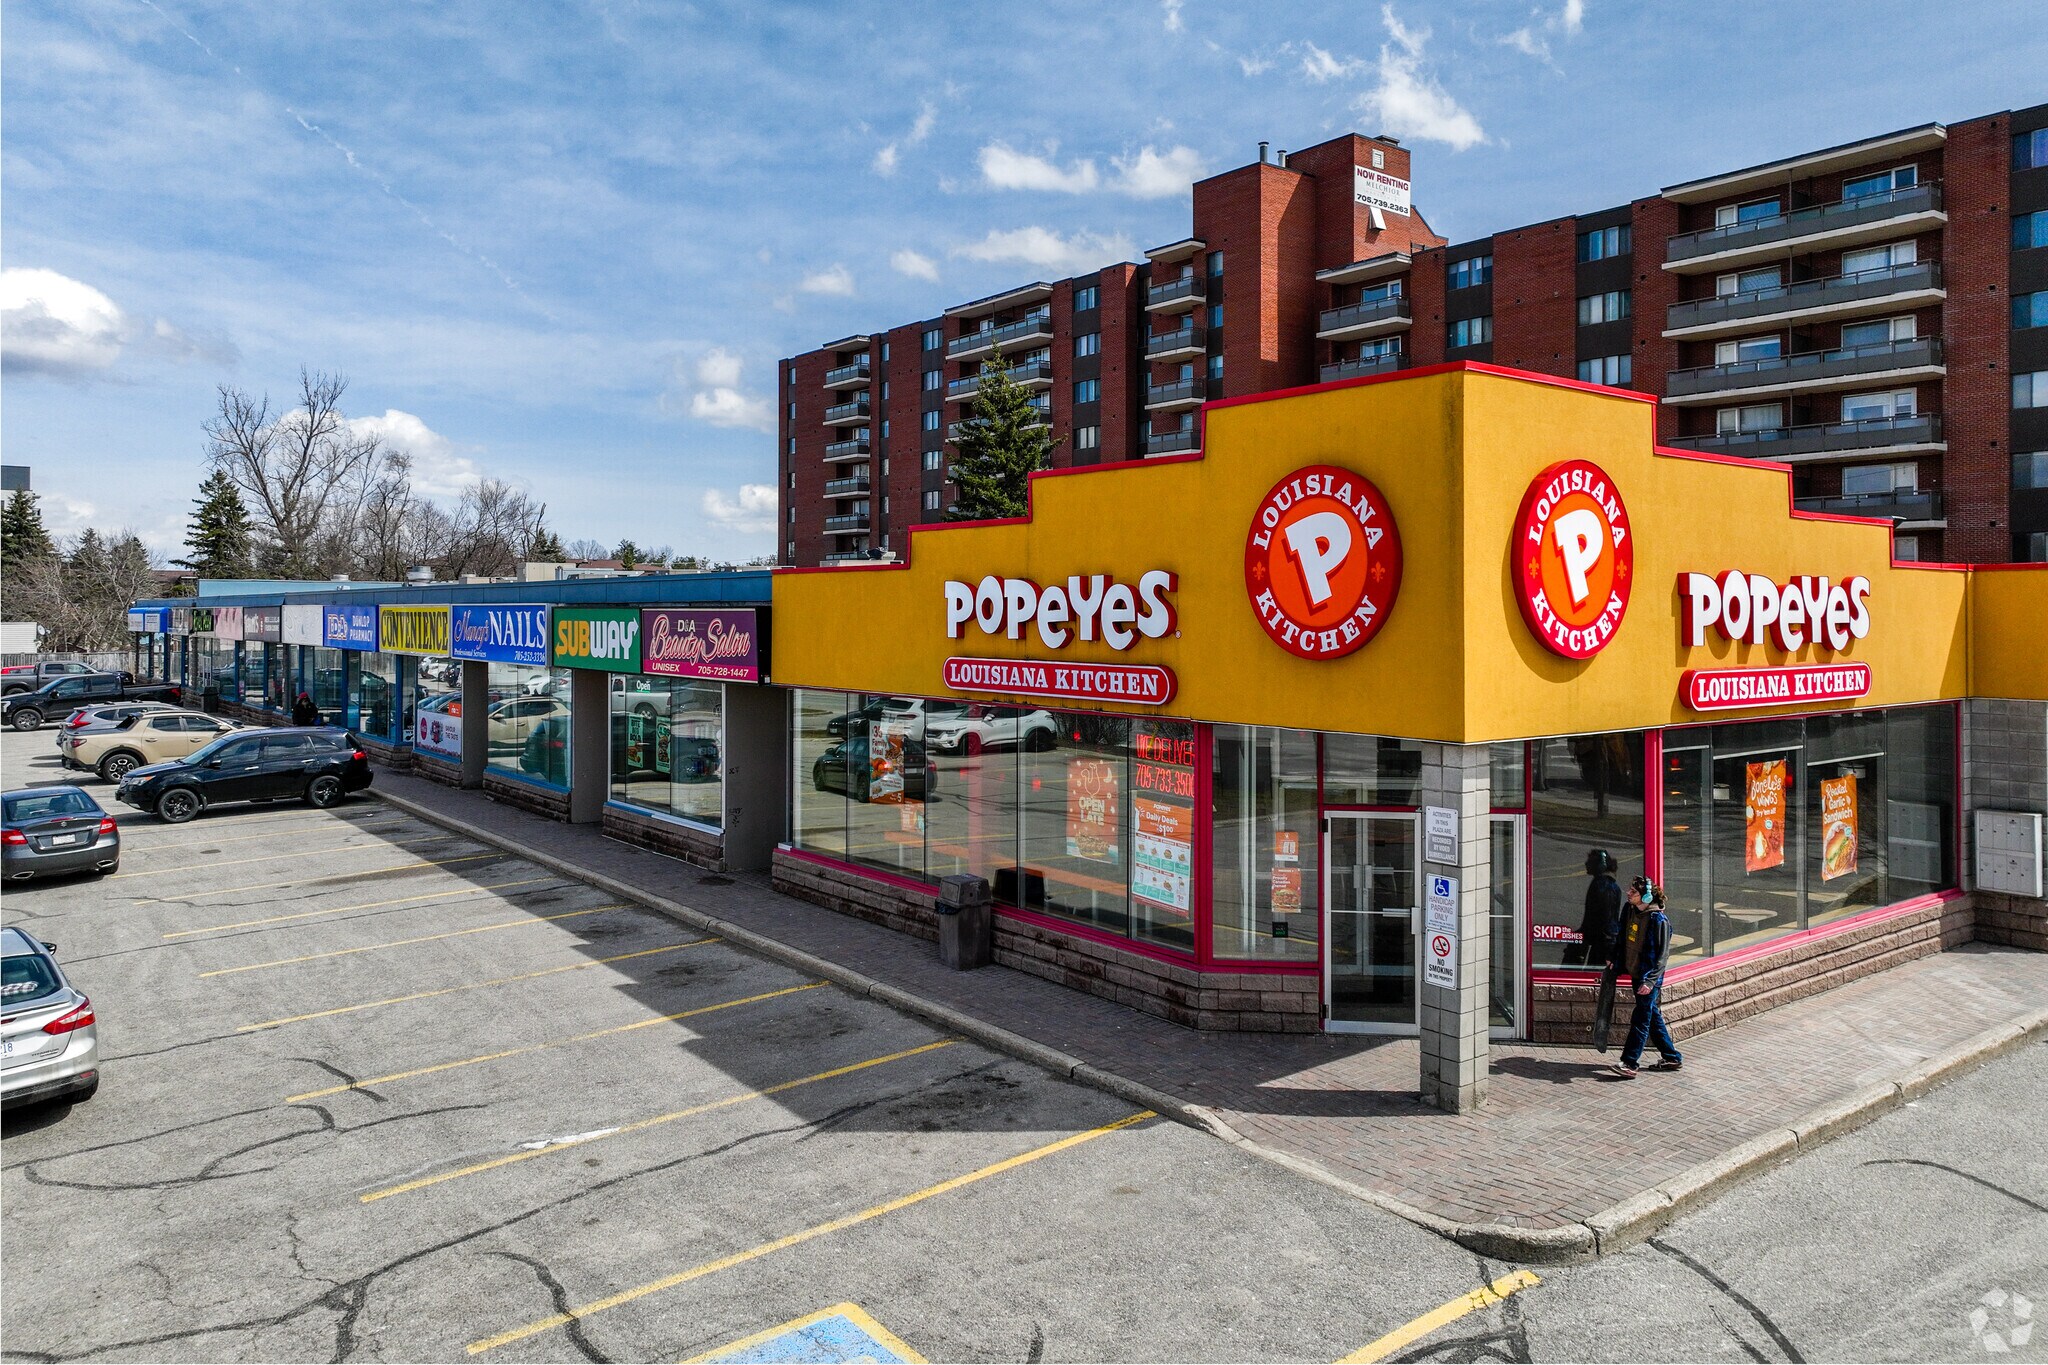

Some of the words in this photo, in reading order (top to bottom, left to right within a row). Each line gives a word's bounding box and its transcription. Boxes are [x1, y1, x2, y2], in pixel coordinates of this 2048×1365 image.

[1357, 168, 1375, 180] NOW
[1376, 175, 1409, 191] RENTING
[1366, 181, 1400, 196] MELCHIOR
[1357, 193, 1409, 214] 705.739.2363
[1253, 474, 1384, 551] LOUISIANA
[1529, 469, 1626, 549] LOUISIANA
[352, 615, 371, 628] DUNLOP
[677, 619, 696, 632] D&A
[1255, 587, 1378, 653] KITCHEN
[1532, 588, 1623, 652] KITCHEN
[350, 629, 374, 642] PHARMACY
[381, 609, 448, 651] CONVENIENCE
[488, 610, 545, 649] NAILS
[555, 618, 639, 660] SUBWAY
[650, 613, 702, 666] Beauty
[701, 617, 751, 663] Salon
[652, 662, 680, 672] UNISEX
[698, 665, 749, 678] 705-728-1447
[636, 680, 651, 691] Open
[950, 663, 1049, 689] LOUISIANA
[1055, 668, 1159, 697] KITCHEN
[1698, 674, 1790, 702] LOUISIANA
[1794, 669, 1867, 695] KITCHEN
[872, 738, 888, 750] Family
[1136, 734, 1152, 759] WE
[872, 748, 884, 756] Meal
[1826, 780, 1848, 799] Roasted
[1078, 796, 1105, 812] OPEN
[1829, 797, 1846, 810] Garlic
[1080, 810, 1105, 826] LATE
[1146, 811, 1161, 823] Daily
[1161, 814, 1178, 826] Deals
[1432, 811, 1452, 819] ACTIVITIES
[1824, 808, 1853, 824] Sandwich
[1432, 836, 1452, 845] RECORDED
[1428, 851, 1456, 861] SURVEILLANCE
[1429, 896, 1455, 906] HANDICAP
[1431, 904, 1453, 914] PARKING
[1434, 913, 1449, 921] ONLY
[1533, 925, 1562, 938] SKIP
[1562, 932, 1583, 940] DISHES
[1437, 958, 1445, 966] NO
[1428, 964, 1453, 976] SMOKING
[1, 1042, 13, 1054] 18
